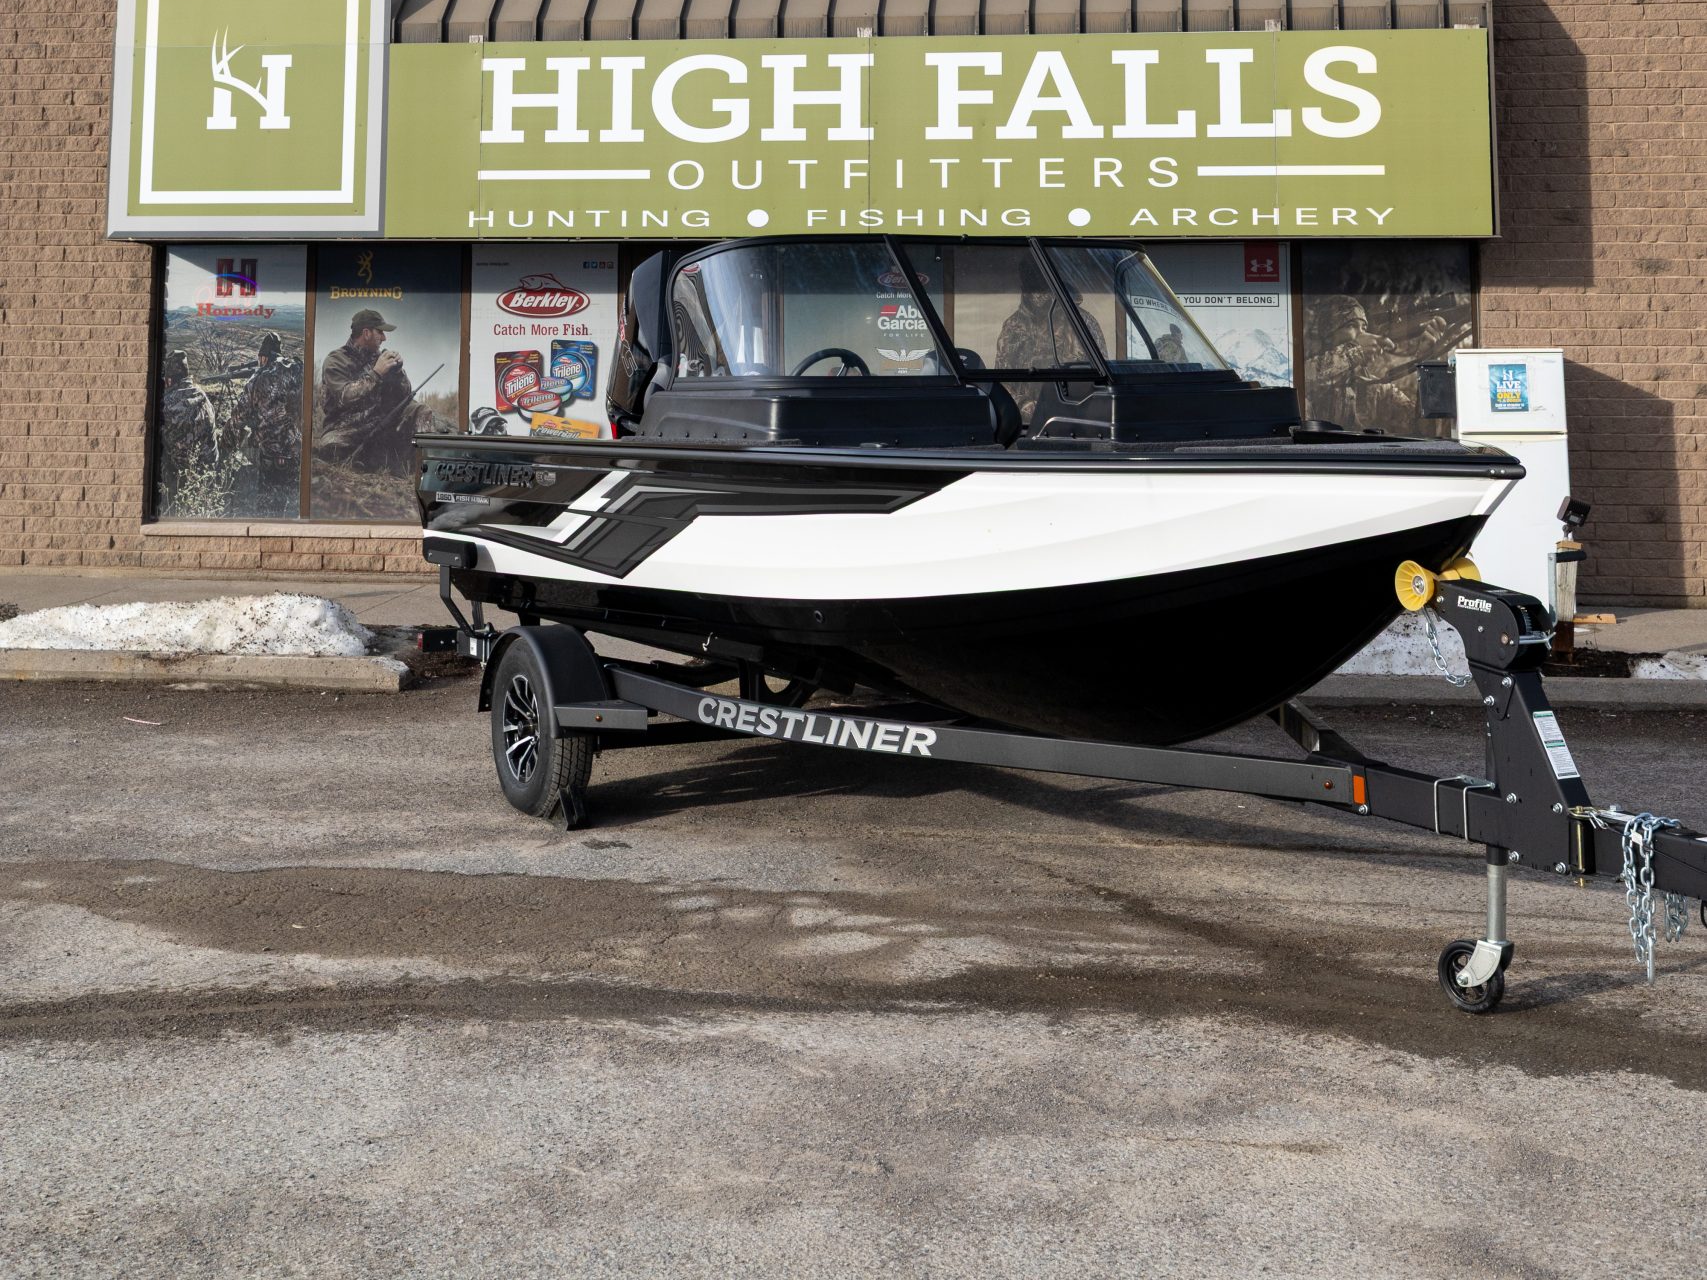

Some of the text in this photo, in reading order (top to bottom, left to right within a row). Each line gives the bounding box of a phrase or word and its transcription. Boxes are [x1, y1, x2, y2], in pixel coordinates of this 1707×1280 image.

[479, 45, 1383, 144] HIGH FALLS
[667, 156, 1180, 190] OUTFITTERS
[468, 207, 1395, 228] HUNTING FISHING ARCHERY
[330, 286, 402, 300] BROWNING
[1184, 296, 1201, 304] YOU
[1204, 296, 1232, 304] DON'T
[509, 291, 579, 312] Berkley
[1134, 297, 1144, 305] GO
[196, 303, 275, 319] Hornady
[493, 323, 526, 336] Catch
[531, 324, 559, 336] More
[877, 316, 928, 330] Garcia
[553, 363, 581, 378] Trilene
[506, 371, 535, 396] Trilene
[1496, 380, 1521, 389] LIVE
[523, 394, 555, 405] Trilene
[1496, 391, 1521, 399] ONLY
[436, 463, 534, 488] CRESTLINER
[1457, 595, 1493, 610] Profile
[698, 697, 938, 756] CRESTLINER
